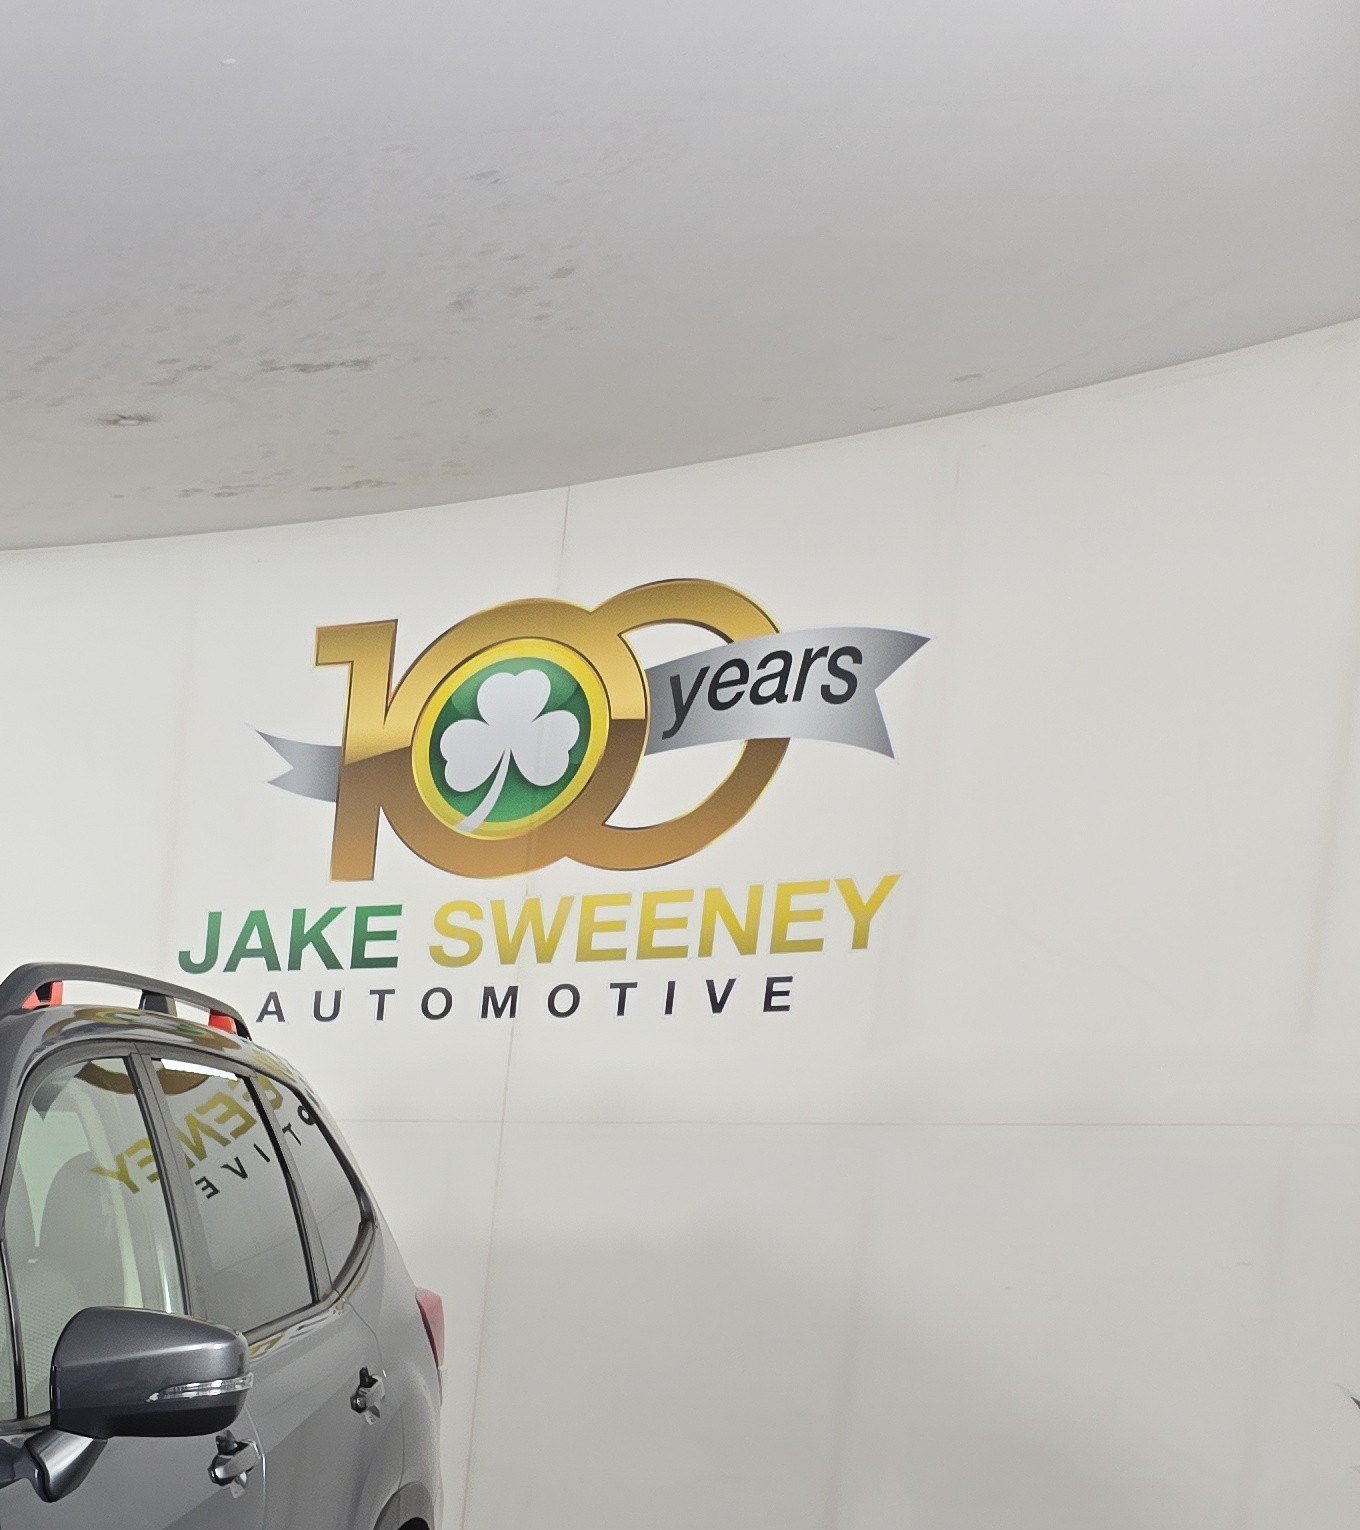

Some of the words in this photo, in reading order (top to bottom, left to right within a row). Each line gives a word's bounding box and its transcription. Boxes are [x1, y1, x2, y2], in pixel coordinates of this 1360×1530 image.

[314, 578, 792, 883] 100
[661, 643, 864, 740] years
[177, 903, 404, 976] JAKE
[427, 873, 902, 968] SWEENEY
[256, 975, 796, 1023] AUTOMOTIVE
